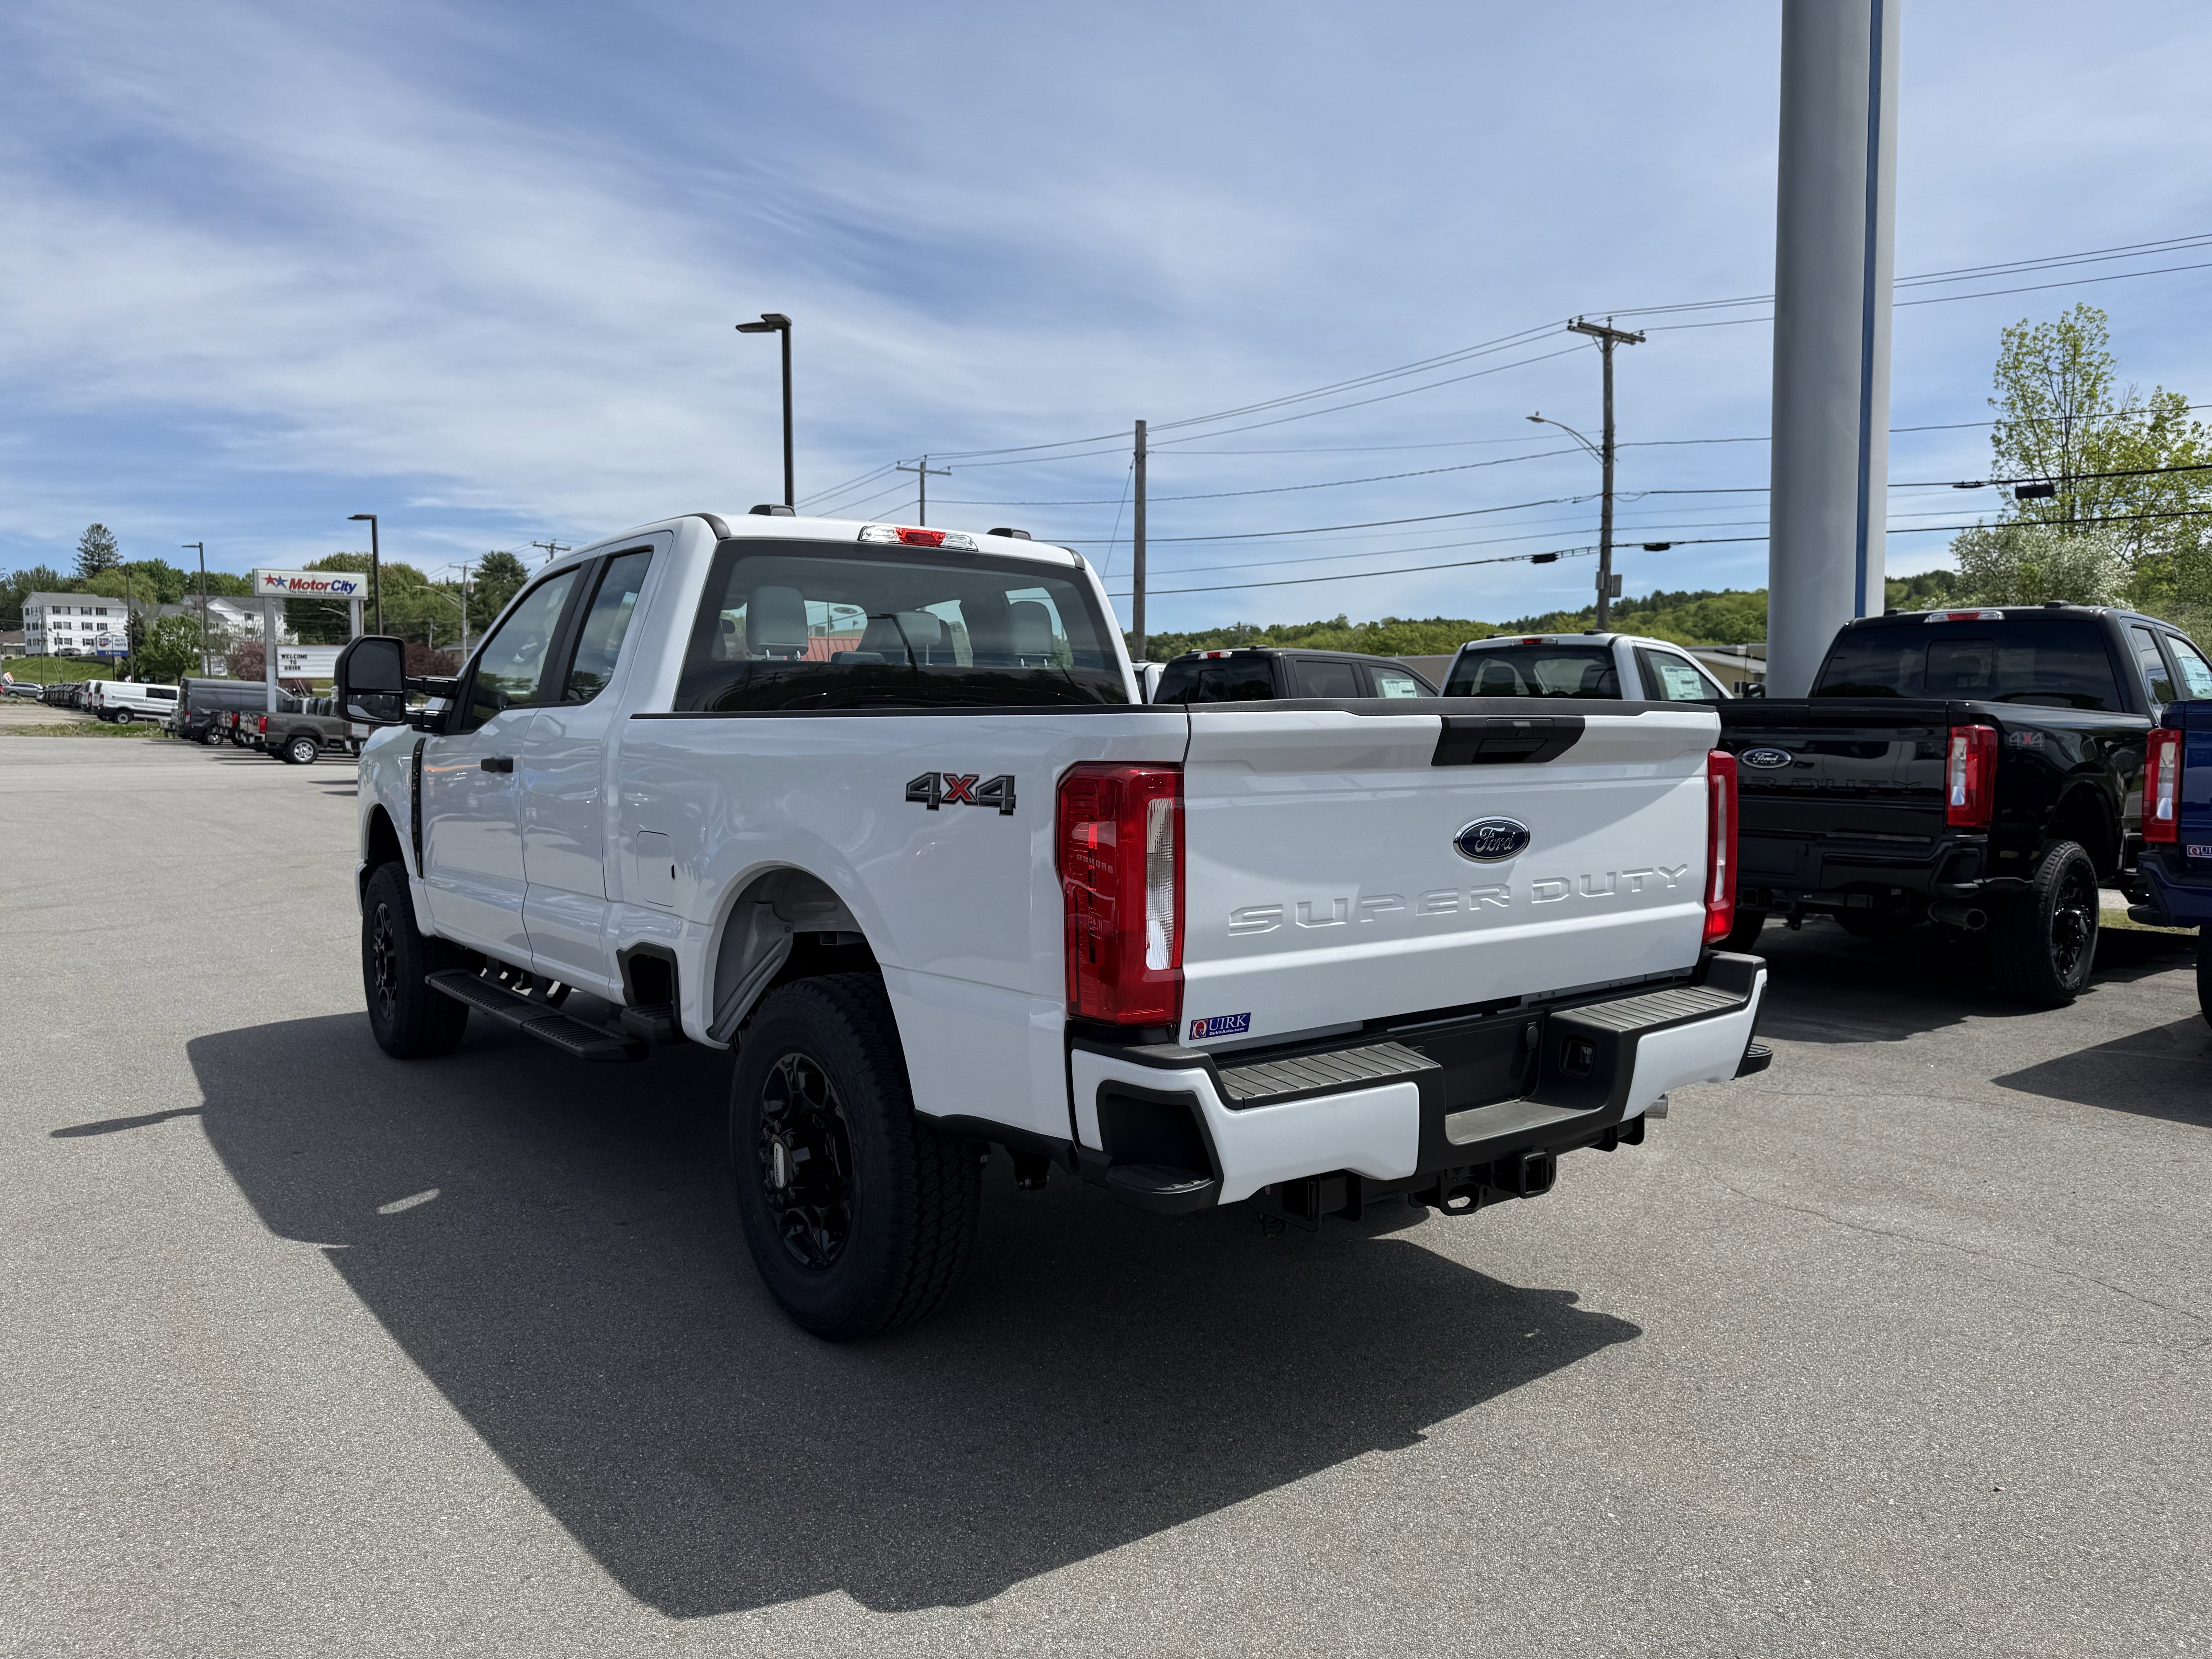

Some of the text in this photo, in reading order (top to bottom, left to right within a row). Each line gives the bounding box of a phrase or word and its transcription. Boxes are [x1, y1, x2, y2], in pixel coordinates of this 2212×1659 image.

[289, 578, 357, 594] MotorCity
[1752, 752, 1779, 764] Ford
[1474, 826, 1516, 853] Ford
[2190, 846, 2212, 855] QUI
[1228, 864, 1688, 936] SUPER DUTY
[1193, 1014, 1247, 1038] QUIRK
[1209, 1027, 1244, 1036] QuirkAuto.com
